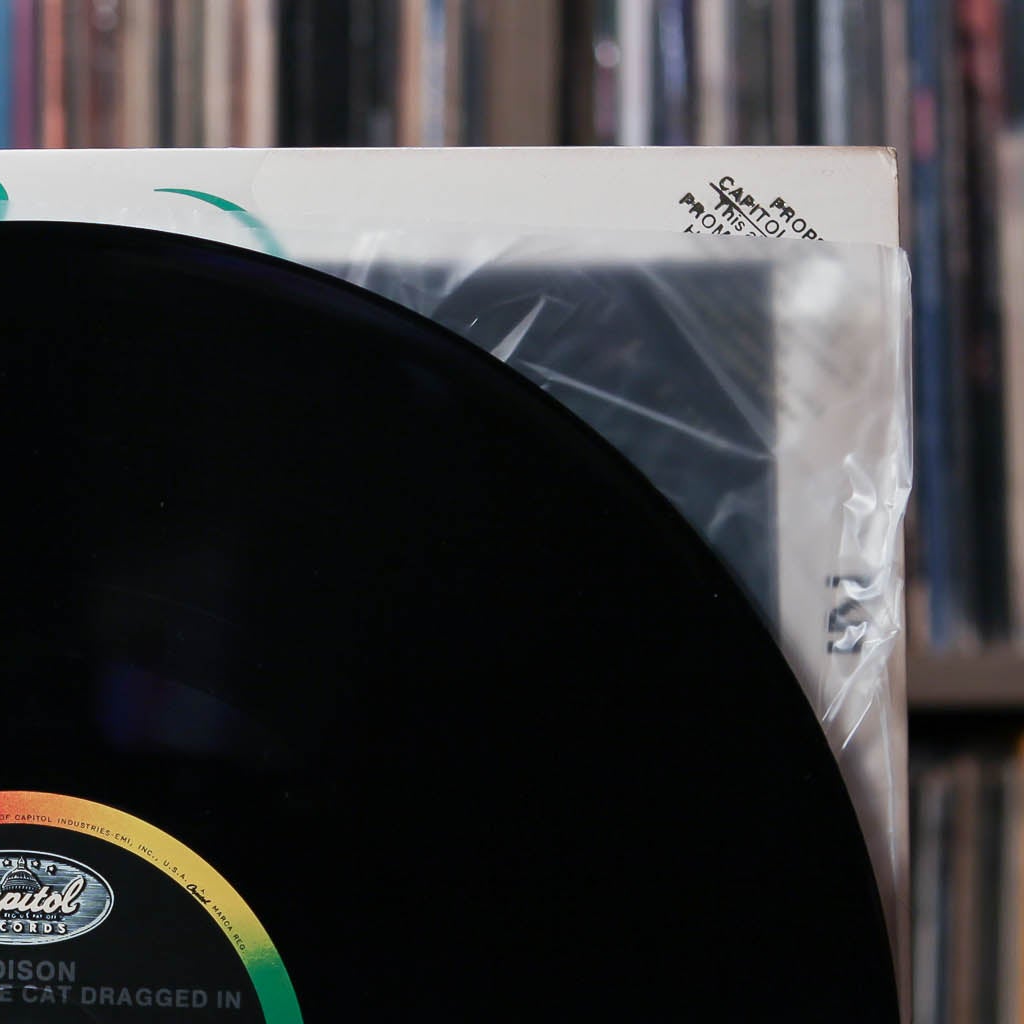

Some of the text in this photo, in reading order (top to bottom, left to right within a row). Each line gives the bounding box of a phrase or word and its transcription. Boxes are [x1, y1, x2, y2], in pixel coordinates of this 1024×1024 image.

[769, 197, 824, 241] PROP
[14, 814, 52, 823] CAPITOL
[57, 817, 133, 847] INDUSTRIES-EMI,
[163, 860, 187, 882] U.S.A.
[212, 905, 233, 932] MARCA
[21, 984, 72, 1004] CAT
[81, 986, 208, 1008] DRAGGED
[217, 990, 241, 1009] IN
